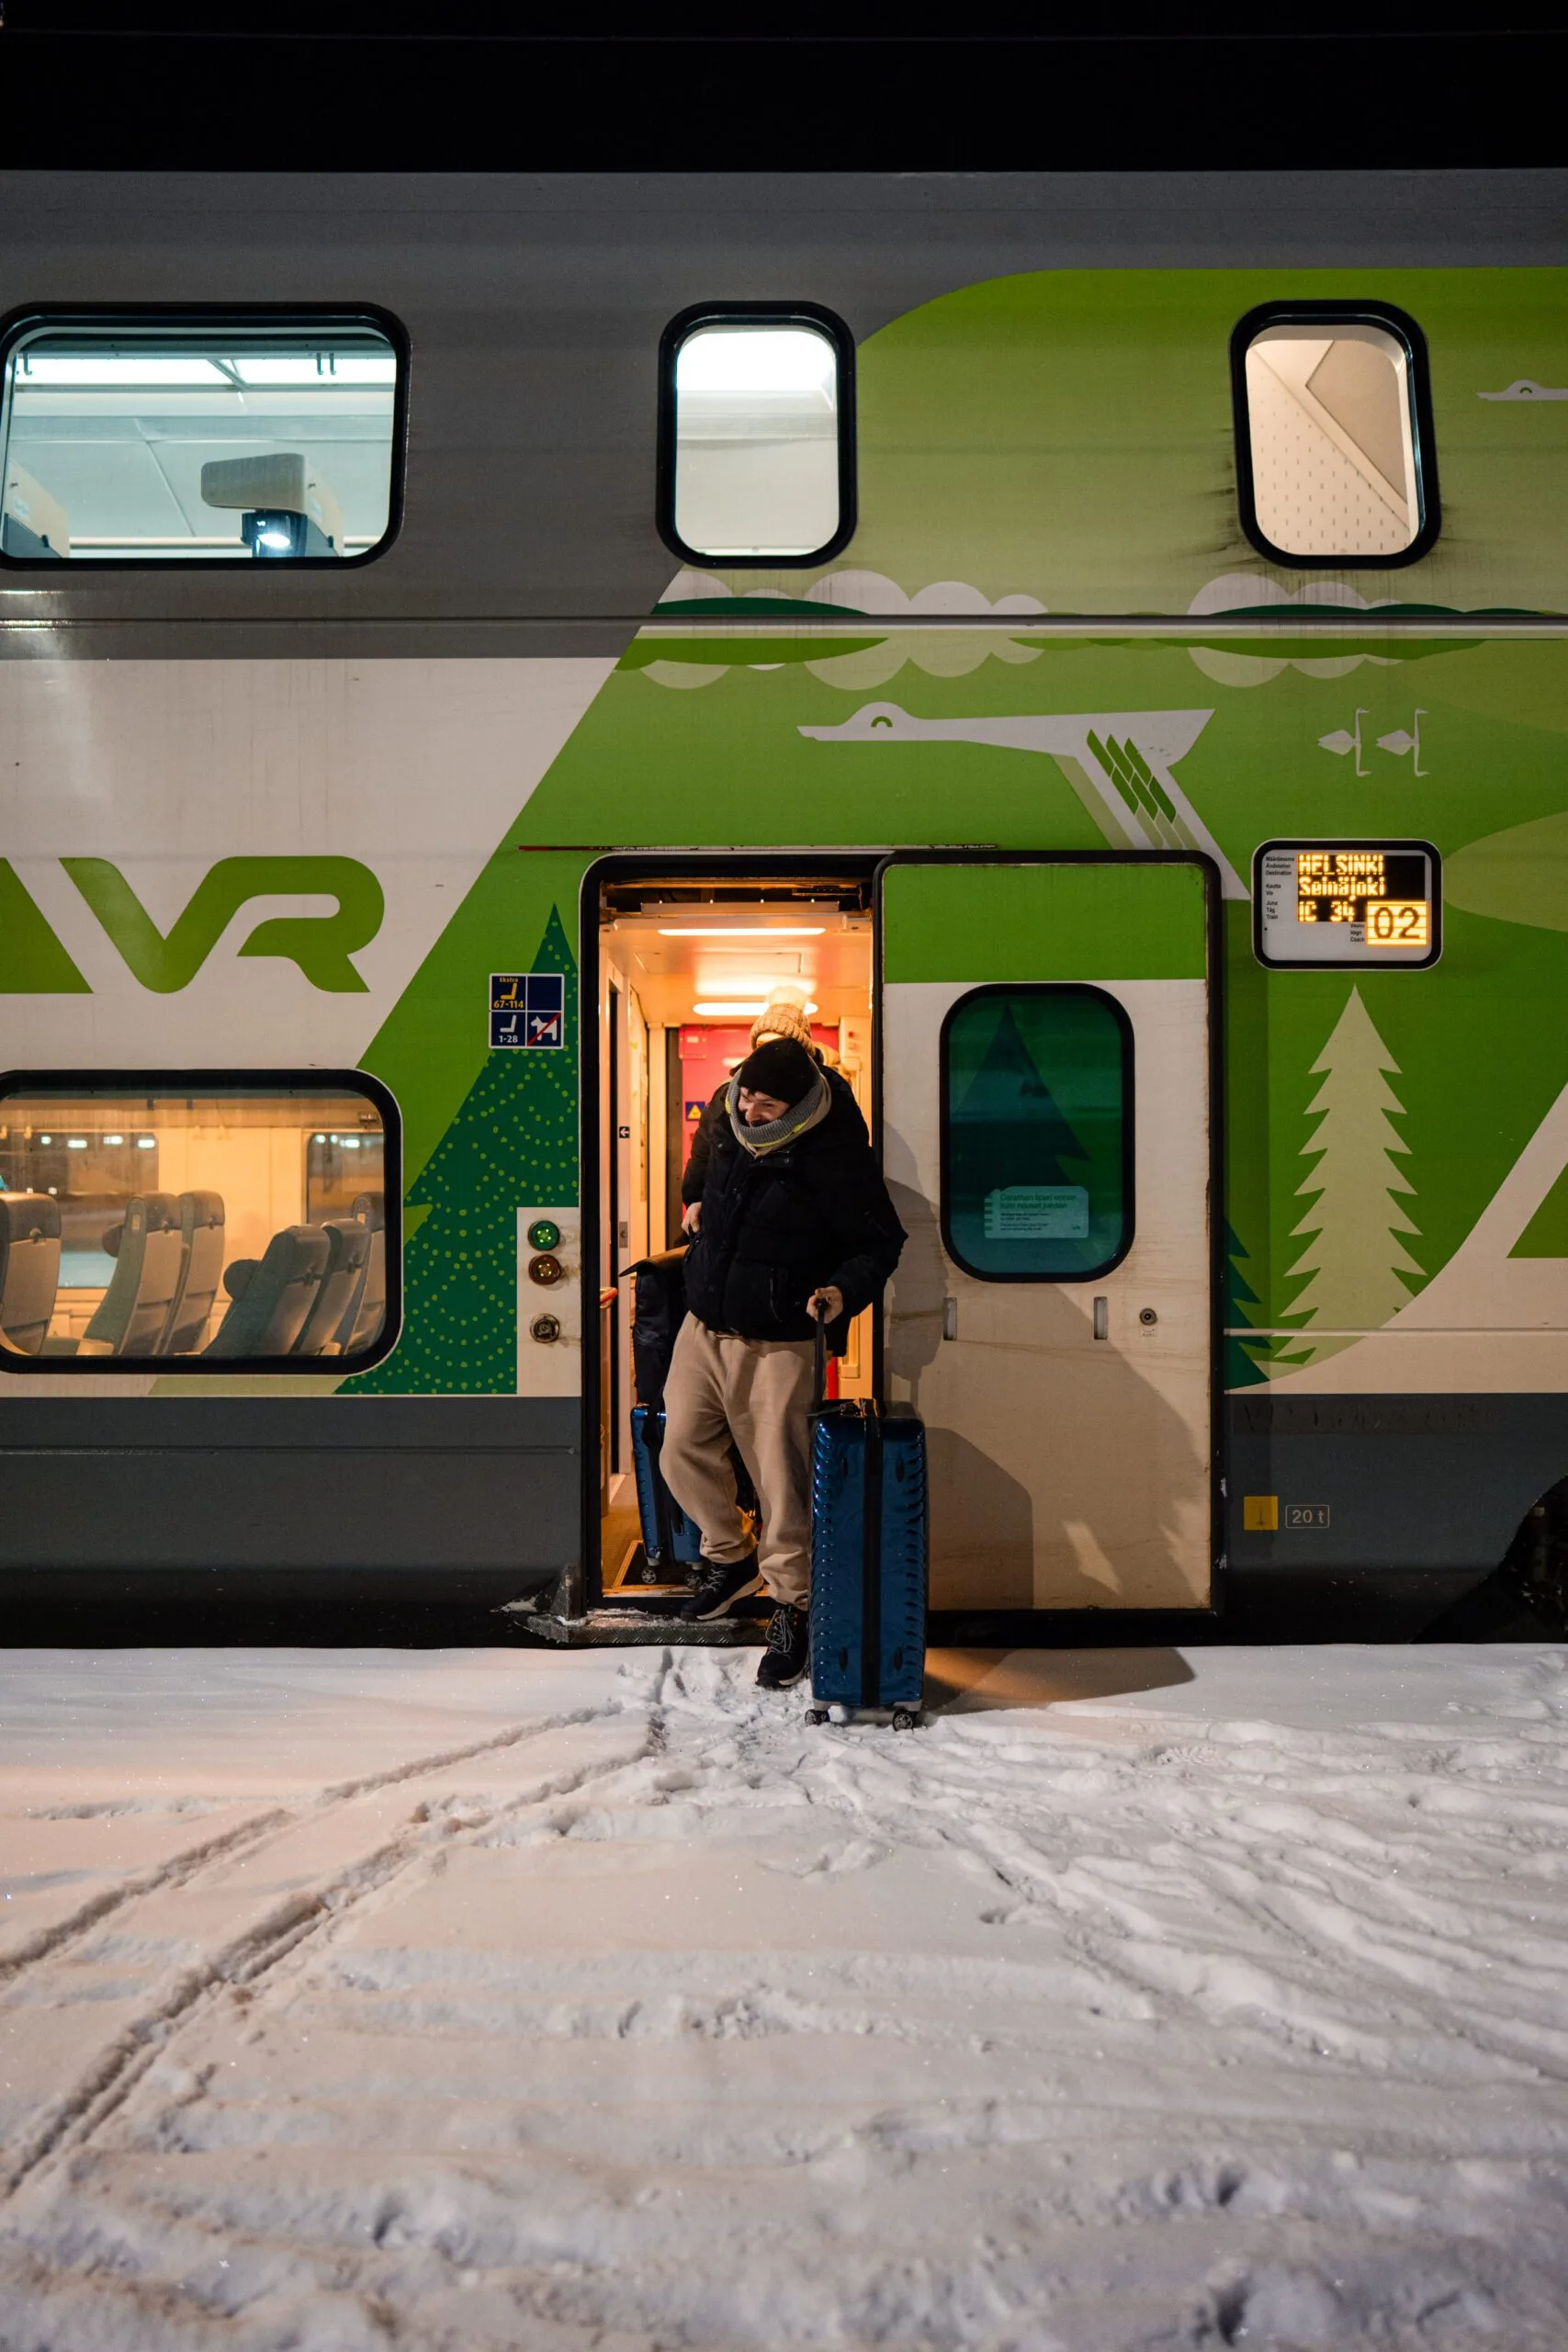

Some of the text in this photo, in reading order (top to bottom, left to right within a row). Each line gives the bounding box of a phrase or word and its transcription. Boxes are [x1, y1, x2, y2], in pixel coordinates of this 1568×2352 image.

[1298, 854, 1384, 876] HELSINKI
[1298, 876, 1385, 902] Seinäjoki
[1298, 900, 1355, 922] IC 34
[59, 855, 385, 993] VR
[1373, 906, 1421, 940] 02
[493, 1000, 524, 1009] 67-114
[498, 1035, 518, 1044] 1-28
[1292, 1510, 1325, 1523] 20 t
